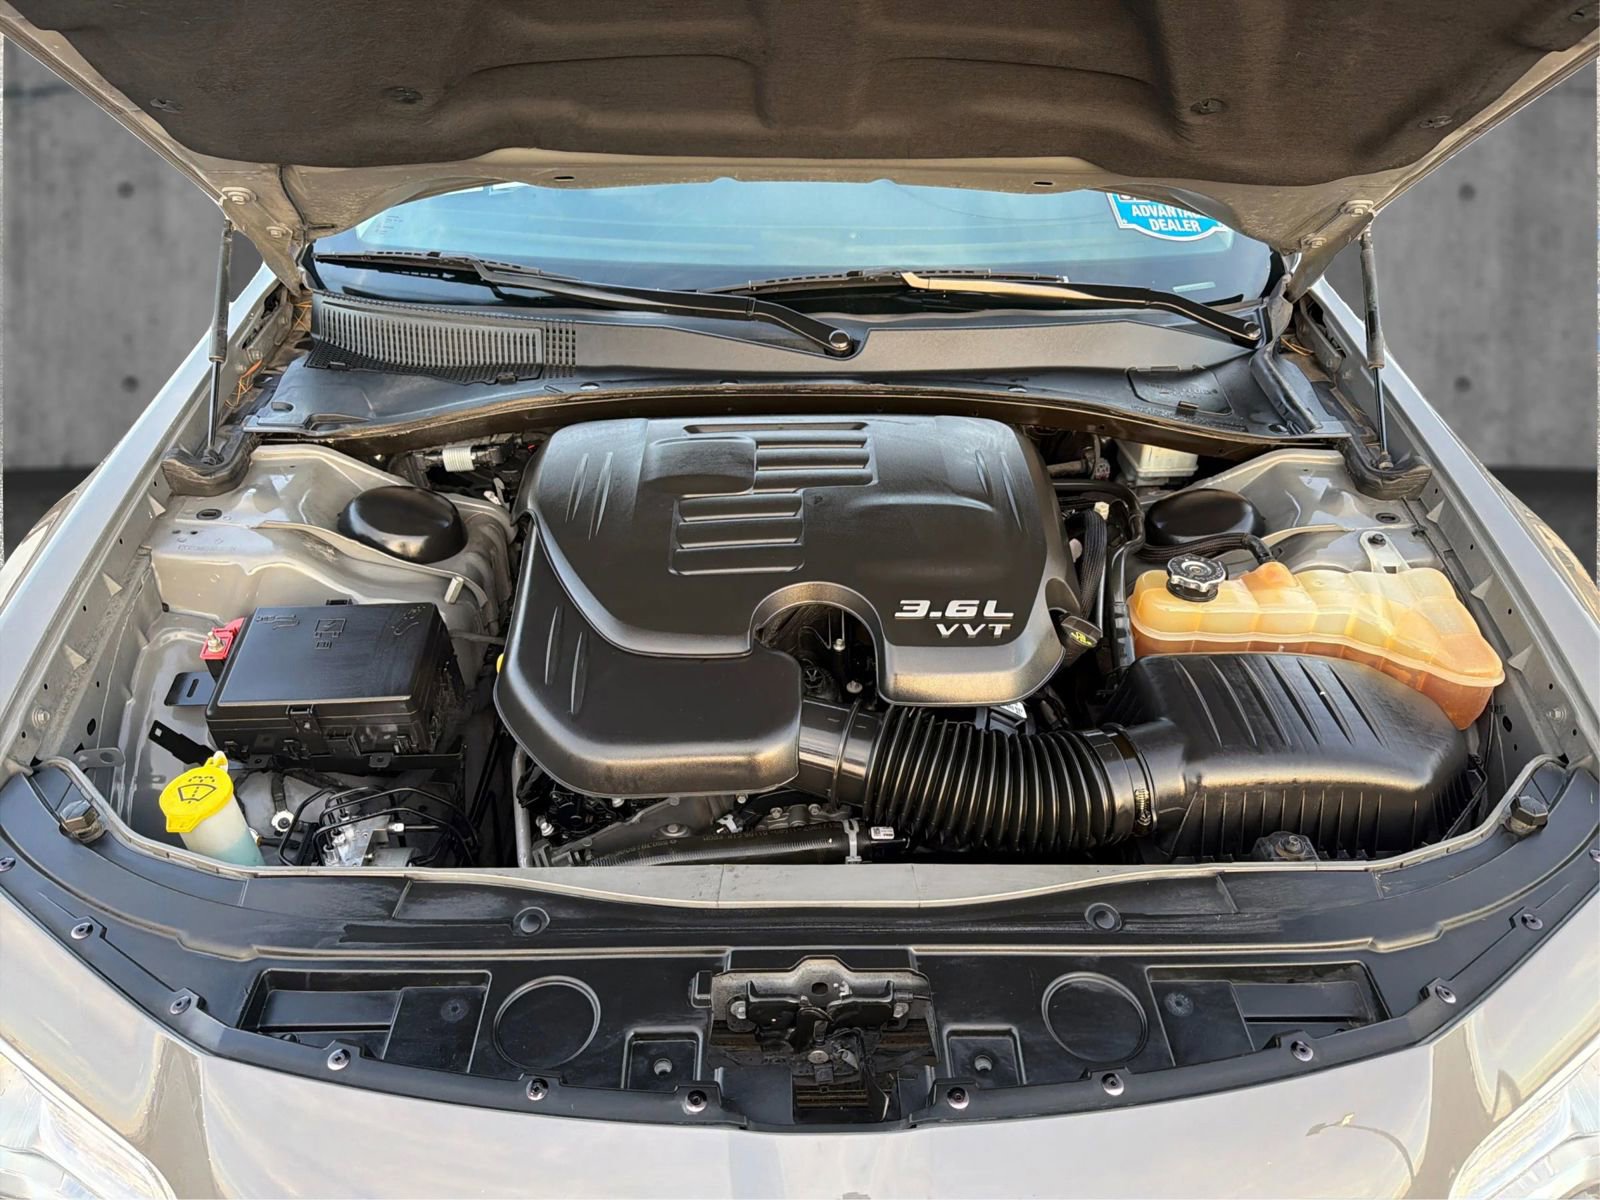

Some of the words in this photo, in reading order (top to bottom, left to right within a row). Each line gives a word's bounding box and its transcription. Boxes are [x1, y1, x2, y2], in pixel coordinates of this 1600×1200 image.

[1150, 219, 1200, 232] DEALER
[894, 600, 1014, 619] 3.6L
[936, 623, 1011, 638] VVT
